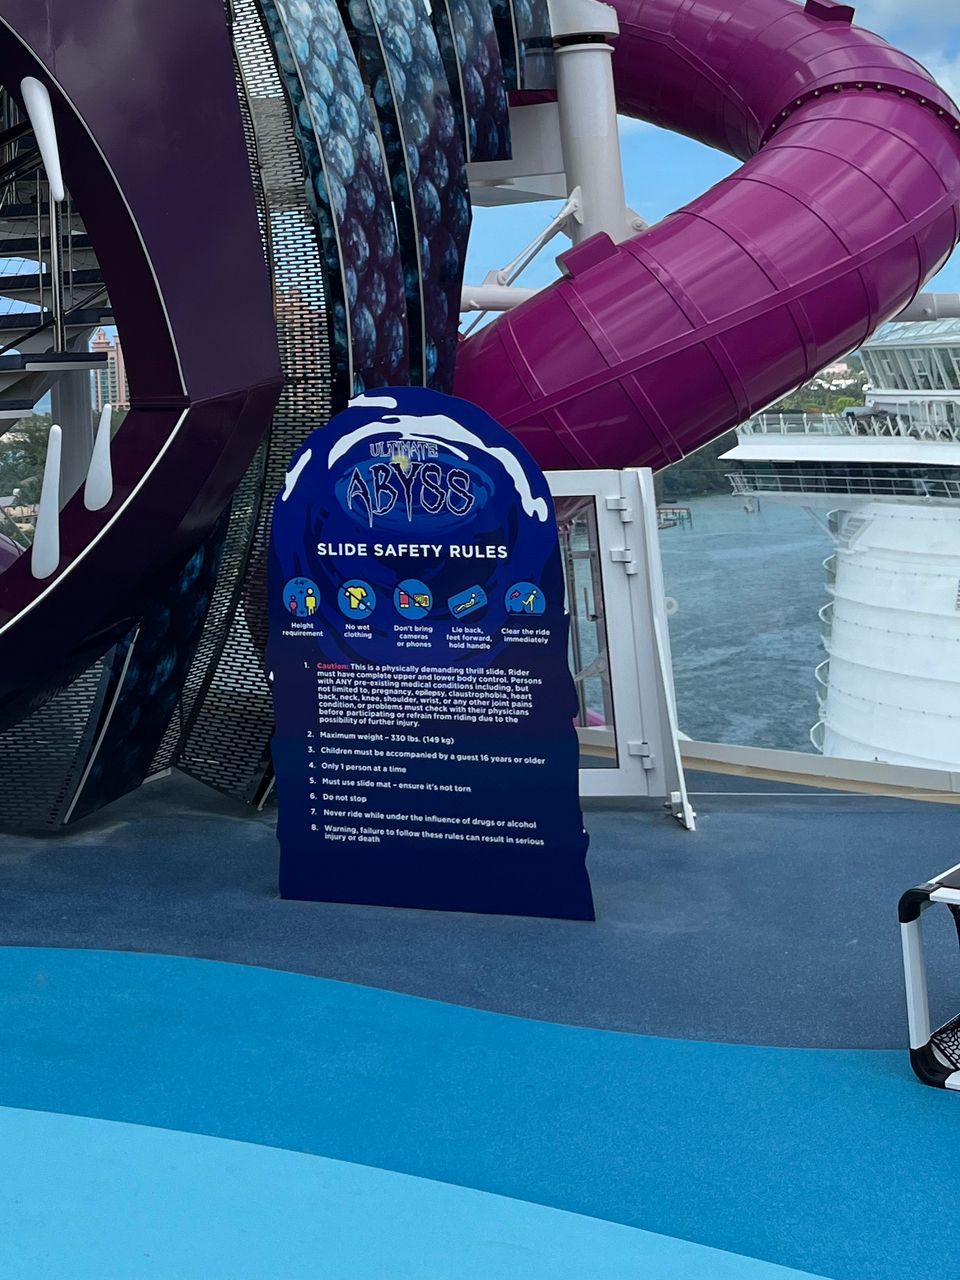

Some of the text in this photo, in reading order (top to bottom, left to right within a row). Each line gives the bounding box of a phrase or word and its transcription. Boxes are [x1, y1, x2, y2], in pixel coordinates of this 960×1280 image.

[370, 440, 438, 459] ULTIMATE
[346, 462, 475, 528] ABYSS
[317, 543, 507, 558] SLIDE SAFETY RULES
[291, 622, 314, 630] Height
[414, 625, 433, 634] bring
[464, 626, 484, 635] back,
[344, 631, 372, 640] clothing
[462, 634, 492, 643] forward,
[504, 635, 548, 645] immediately
[406, 640, 432, 648] phones
[381, 664, 419, 673] physically
[420, 665, 464, 675] demanding
[356, 672, 392, 680] complete
[457, 674, 477, 683] body
[510, 677, 542, 685] Persons
[354, 680, 400, 688] pre-existing
[475, 683, 514, 692] including,
[318, 693, 338, 701] back,
[361, 694, 382, 703] knee,
[383, 695, 419, 704] shoulder,
[371, 688, 414, 696] pregnancy,
[415, 689, 447, 698] epilepsy,
[448, 690, 509, 700] claustrophobia,
[318, 701, 356, 710] condition,
[488, 707, 529, 716] physicians
[319, 716, 358, 725] possibility
[368, 718, 395, 726] further
[396, 719, 420, 728] injury.
[346, 710, 395, 719] participating
[454, 714, 477, 722] riding
[320, 731, 356, 739] Maximum
[357, 733, 383, 741] weight
[422, 735, 440, 743] (149
[441, 736, 454, 745] kg)
[320, 747, 352, 755] Children
[386, 751, 437, 759] accompanied
[438, 752, 448, 761] by
[321, 762, 339, 771] Only
[350, 795, 367, 803] stop
[323, 808, 346, 817] Never
[425, 815, 460, 823] influence
[472, 817, 495, 826] drugs
[507, 820, 536, 828] alcohol
[324, 824, 359, 834] Warning,
[360, 826, 385, 835] failure
[396, 828, 420, 837] follow
[421, 830, 443, 838] these
[324, 833, 346, 842] injury
[358, 834, 380, 842] death
